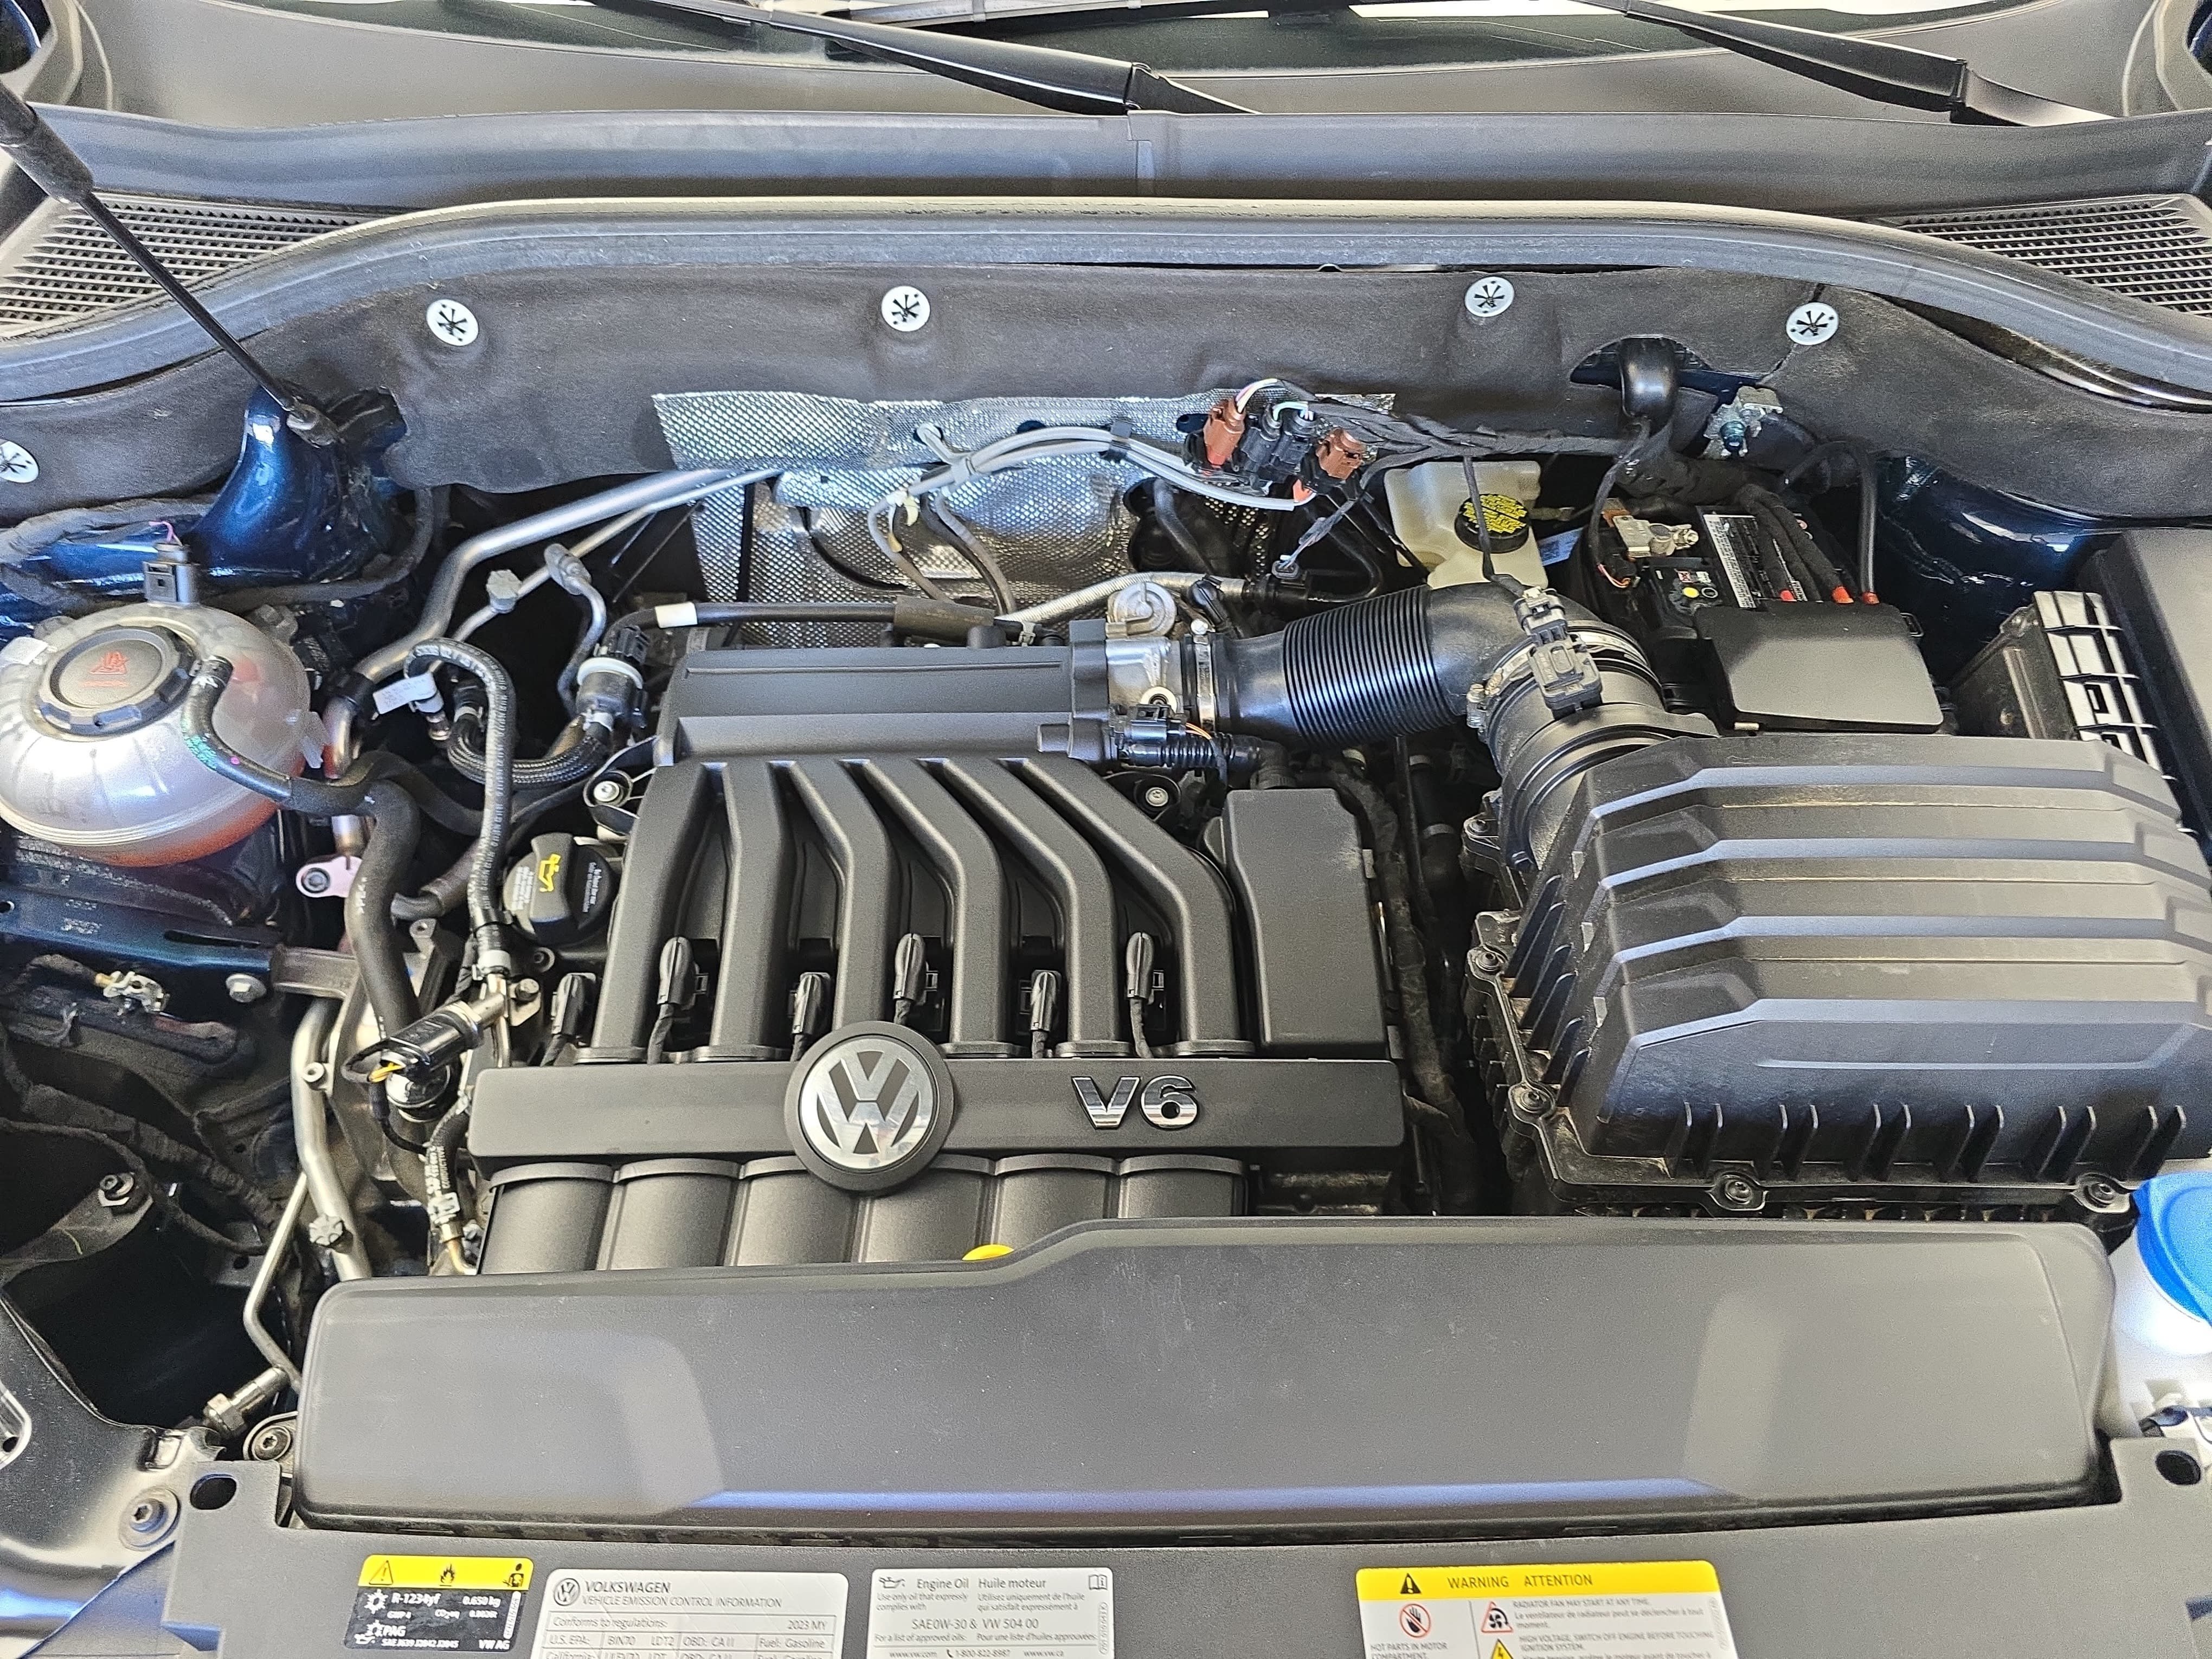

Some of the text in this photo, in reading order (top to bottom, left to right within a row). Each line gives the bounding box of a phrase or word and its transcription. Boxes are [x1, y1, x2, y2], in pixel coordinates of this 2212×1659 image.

[1071, 1075, 1198, 1130] V6
[436, 1145, 451, 1189] CONDUCTIVE
[585, 1581, 671, 1593] VOLKSWAGEN
[917, 1578, 969, 1591] Engine Oil
[978, 1577, 1046, 1589] Huile moteur
[1448, 1574, 1593, 1589] WARNING ATTENTION
[391, 1592, 442, 1607] R-1234yf
[488, 1596, 501, 1607] kg
[582, 1596, 782, 1607] VEHICLE EMISSION CONTROL INFORMATION
[1007, 1593, 1050, 1603] uniquement
[876, 1603, 927, 1612] complies with
[1512, 1600, 1549, 1608] RADIATOR
[552, 1616, 599, 1627] Conforms
[600, 1618, 611, 1627] to
[787, 1619, 828, 1631] 2023 MY
[911, 1618, 1039, 1630] SAE0W-30 & VW 504 00
[382, 1625, 407, 1637] PAG
[976, 1632, 994, 1641] Pour
[1618, 1632, 1645, 1640] ENGINE
[1647, 1631, 1675, 1639] BEFORE
[1676, 1631, 1714, 1639] TOUCHING
[607, 1636, 674, 1646] BIN70 LDT2
[711, 1637, 725, 1647] CA
[759, 1637, 825, 1649] Fuel: Gasoline
[916, 1633, 950, 1644] approved
[479, 1639, 511, 1650] VW AG
[1371, 1642, 1448, 1651] HOT PARTS IN MOTOR
